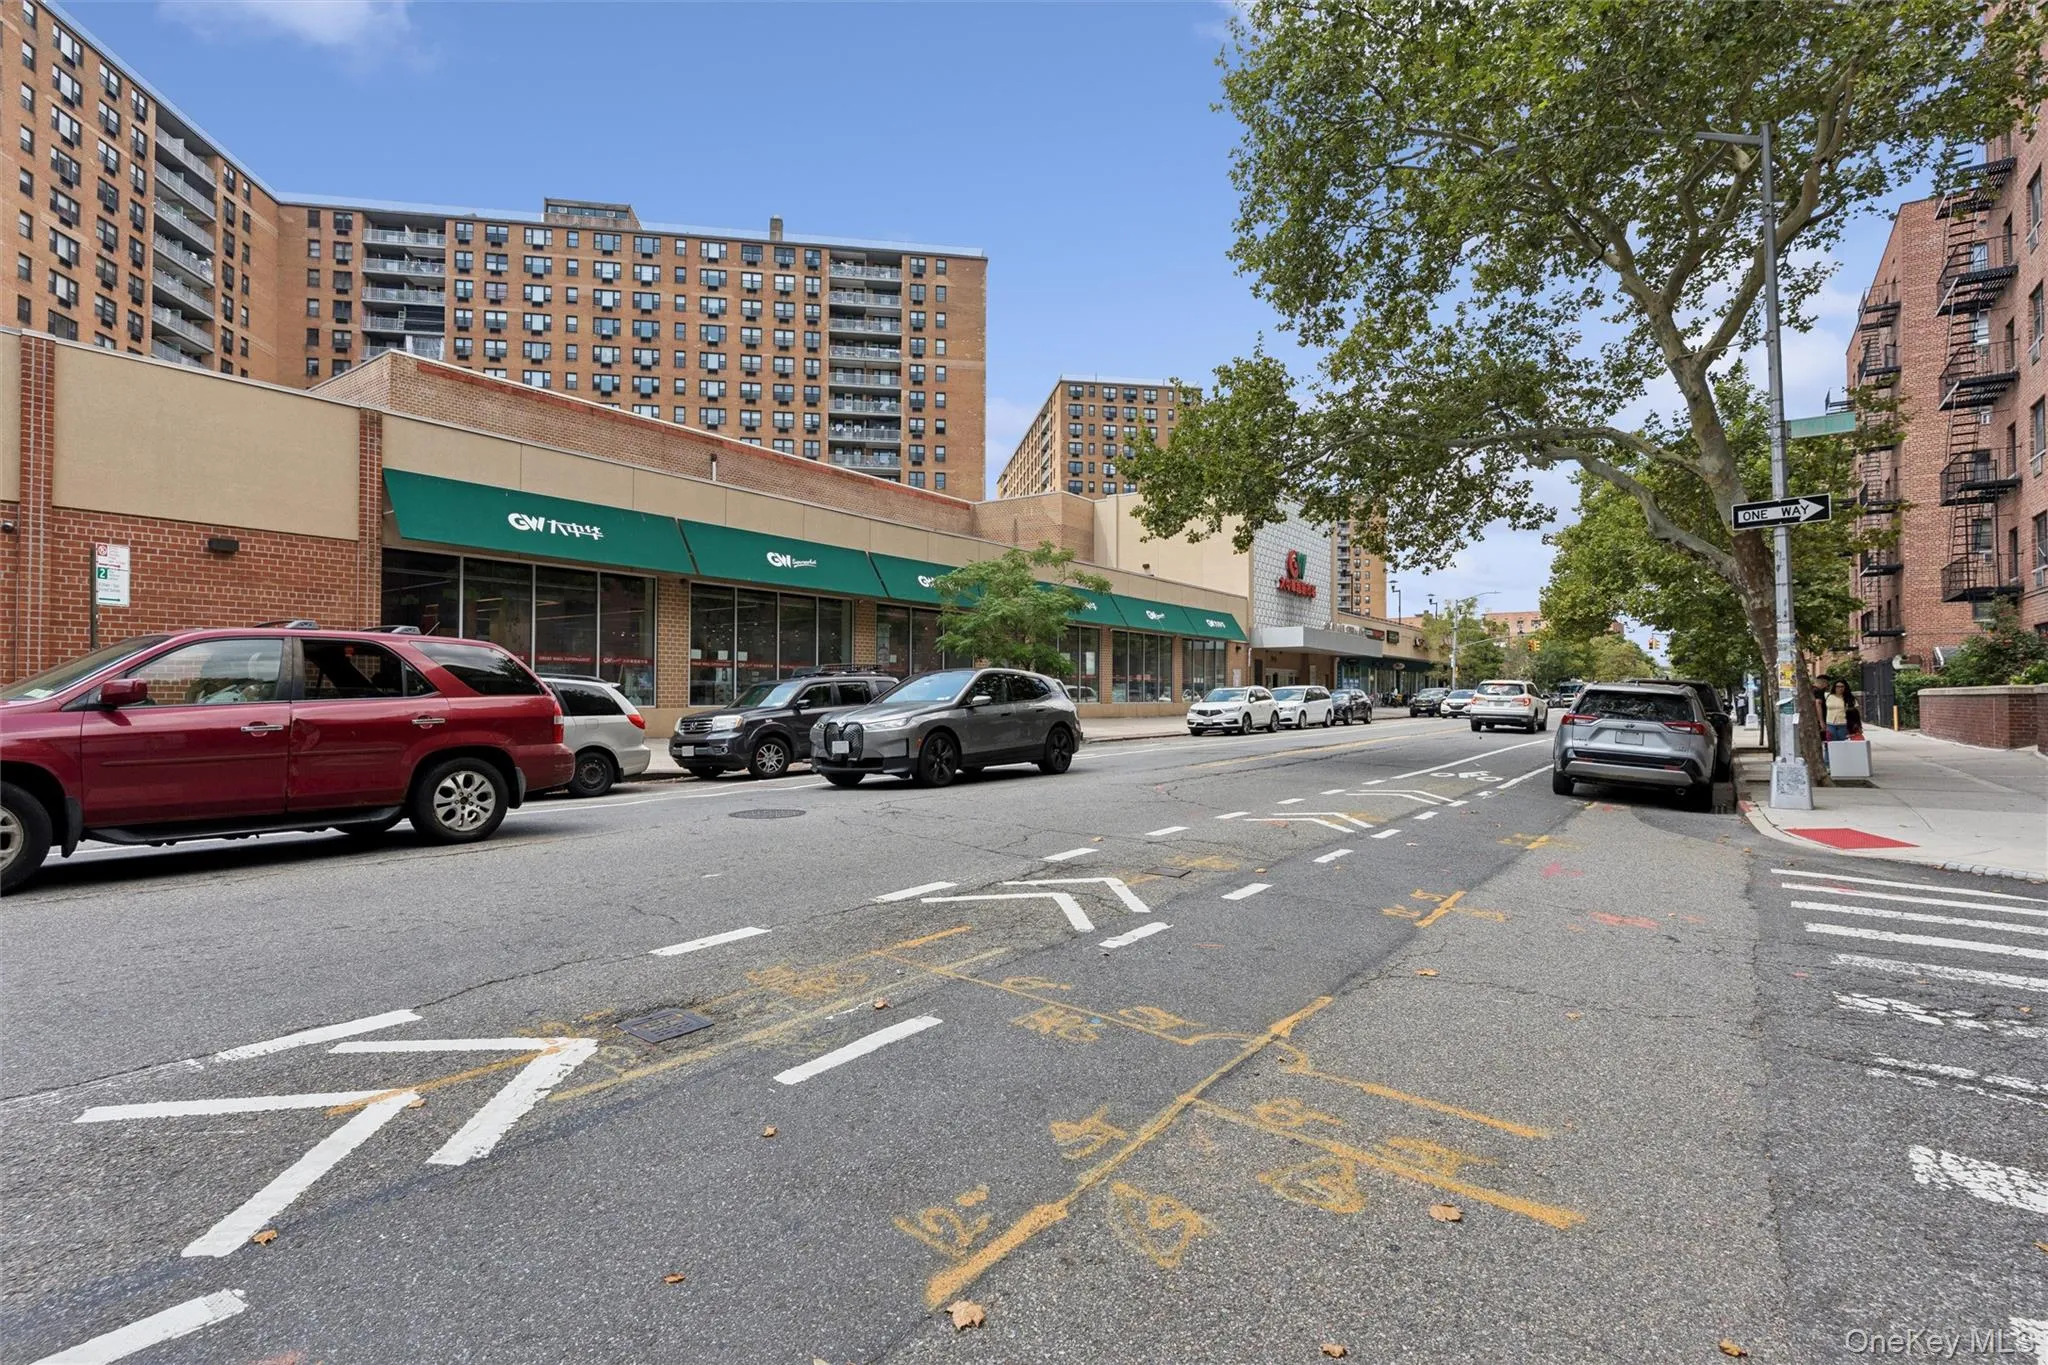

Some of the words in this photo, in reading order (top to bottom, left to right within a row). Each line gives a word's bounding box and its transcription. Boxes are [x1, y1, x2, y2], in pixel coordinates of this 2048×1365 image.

[1743, 509, 1768, 521] ONE
[1781, 504, 1809, 517] WAY
[508, 512, 546, 532] GW
[766, 551, 792, 568] GW
